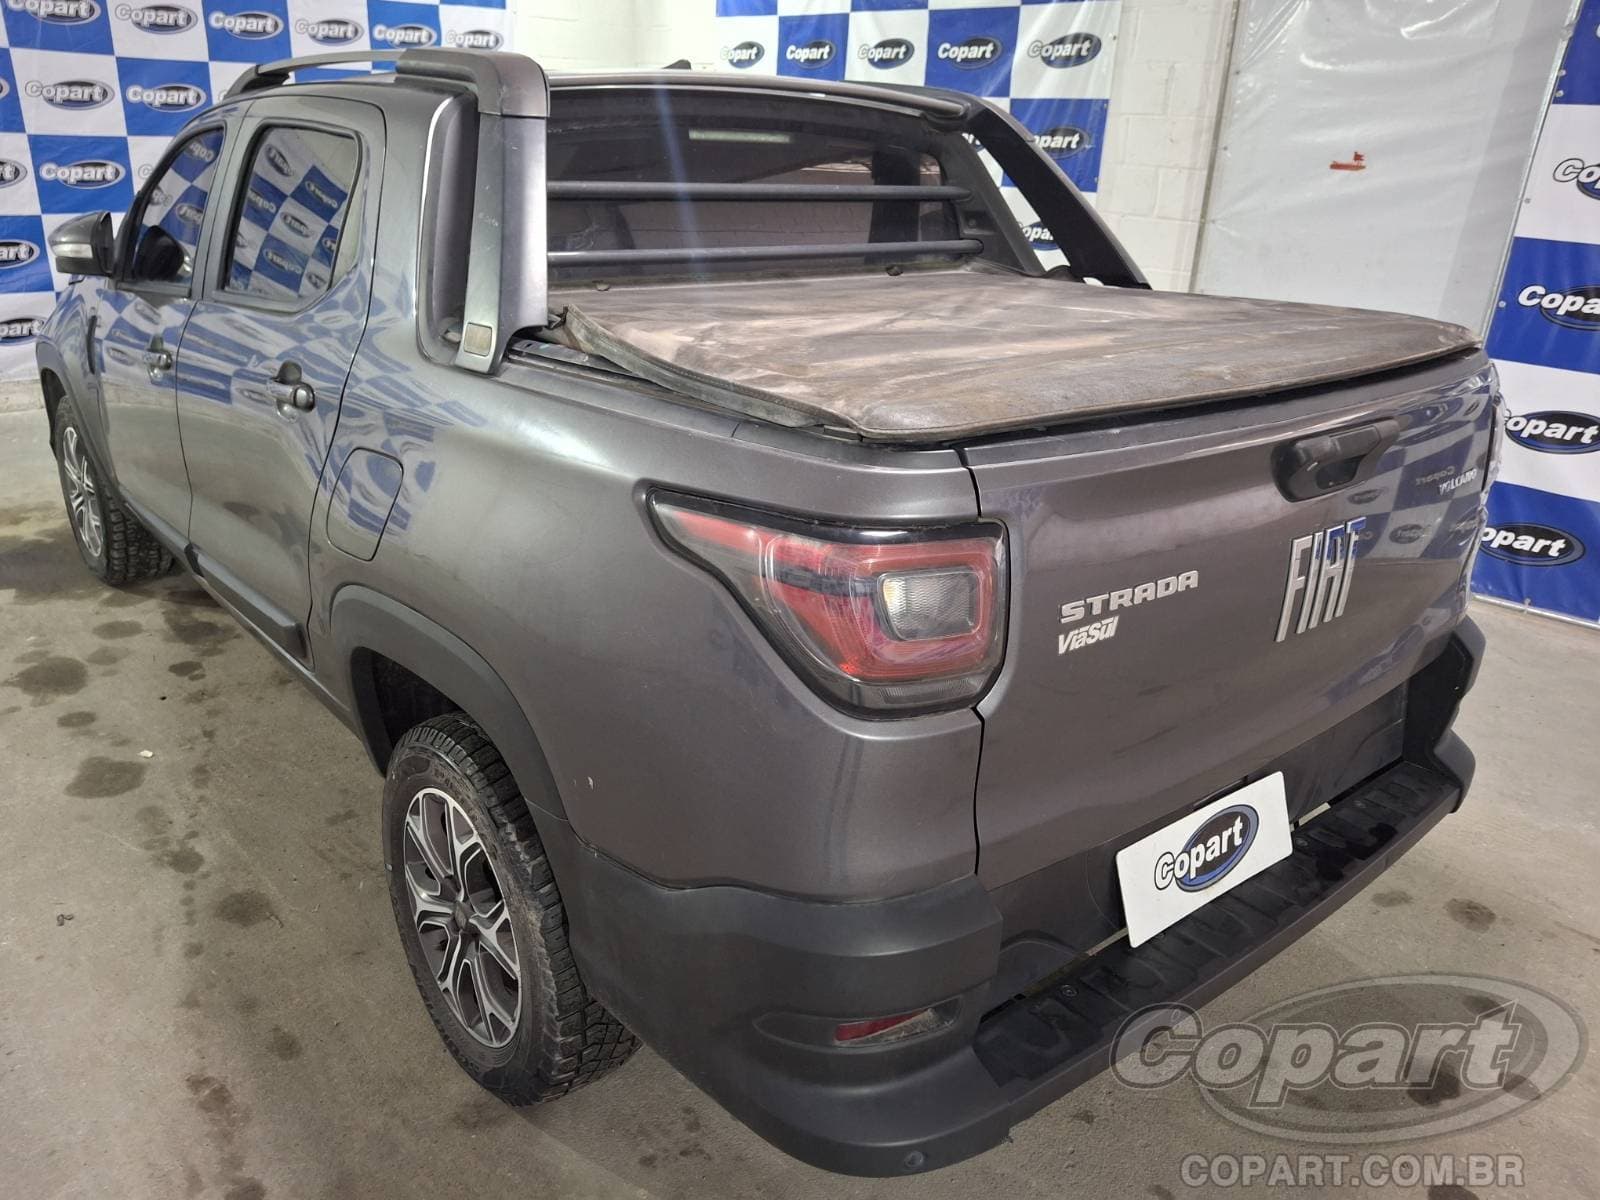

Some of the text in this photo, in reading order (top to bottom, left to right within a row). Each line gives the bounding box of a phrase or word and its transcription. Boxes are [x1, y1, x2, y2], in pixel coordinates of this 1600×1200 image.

[9, 0, 90, 17] Copart
[115, 4, 189, 27] Copart
[208, 12, 276, 34] Copart
[296, 20, 356, 39] Copart
[373, 24, 431, 44] Copart
[447, 29, 496, 47] Copart
[720, 46, 757, 62] Copart
[786, 45, 830, 62] Copart
[857, 43, 907, 62] Copart
[938, 41, 995, 62] Copart
[1028, 39, 1090, 63] Copart
[25, 80, 104, 105] Copart
[127, 84, 198, 107] Copart
[1033, 132, 1080, 149] part
[40, 162, 117, 185] Copart
[0, 243, 29, 260] art
[1518, 285, 1600, 315] Copa
[0, 319, 42, 337] part
[1480, 527, 1566, 557] opart
[1274, 516, 1366, 643] FIAT
[1058, 570, 1198, 623] STRADA
[1154, 810, 1244, 891] Copart
